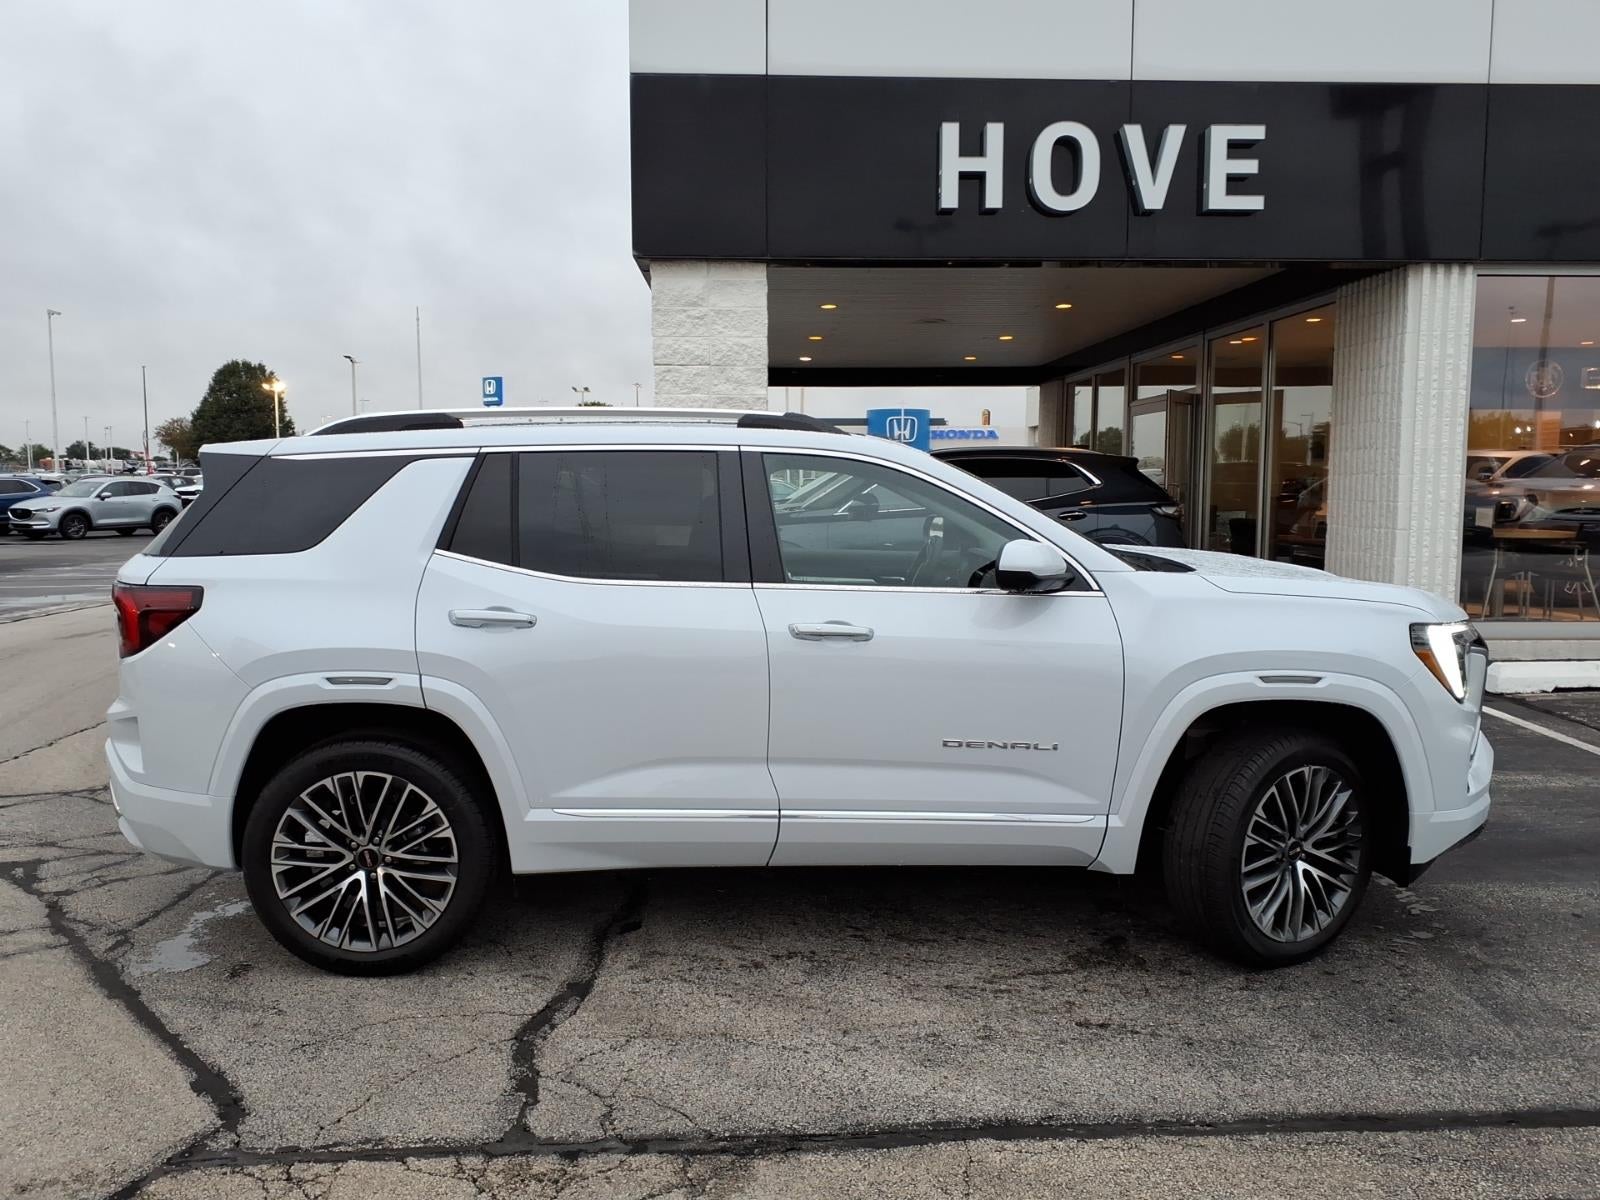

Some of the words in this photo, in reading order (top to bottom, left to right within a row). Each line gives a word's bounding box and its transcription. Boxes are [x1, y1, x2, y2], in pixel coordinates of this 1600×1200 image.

[938, 120, 1267, 213] HOVE
[930, 429, 999, 440] HONDA
[942, 740, 1059, 751] DENALI
